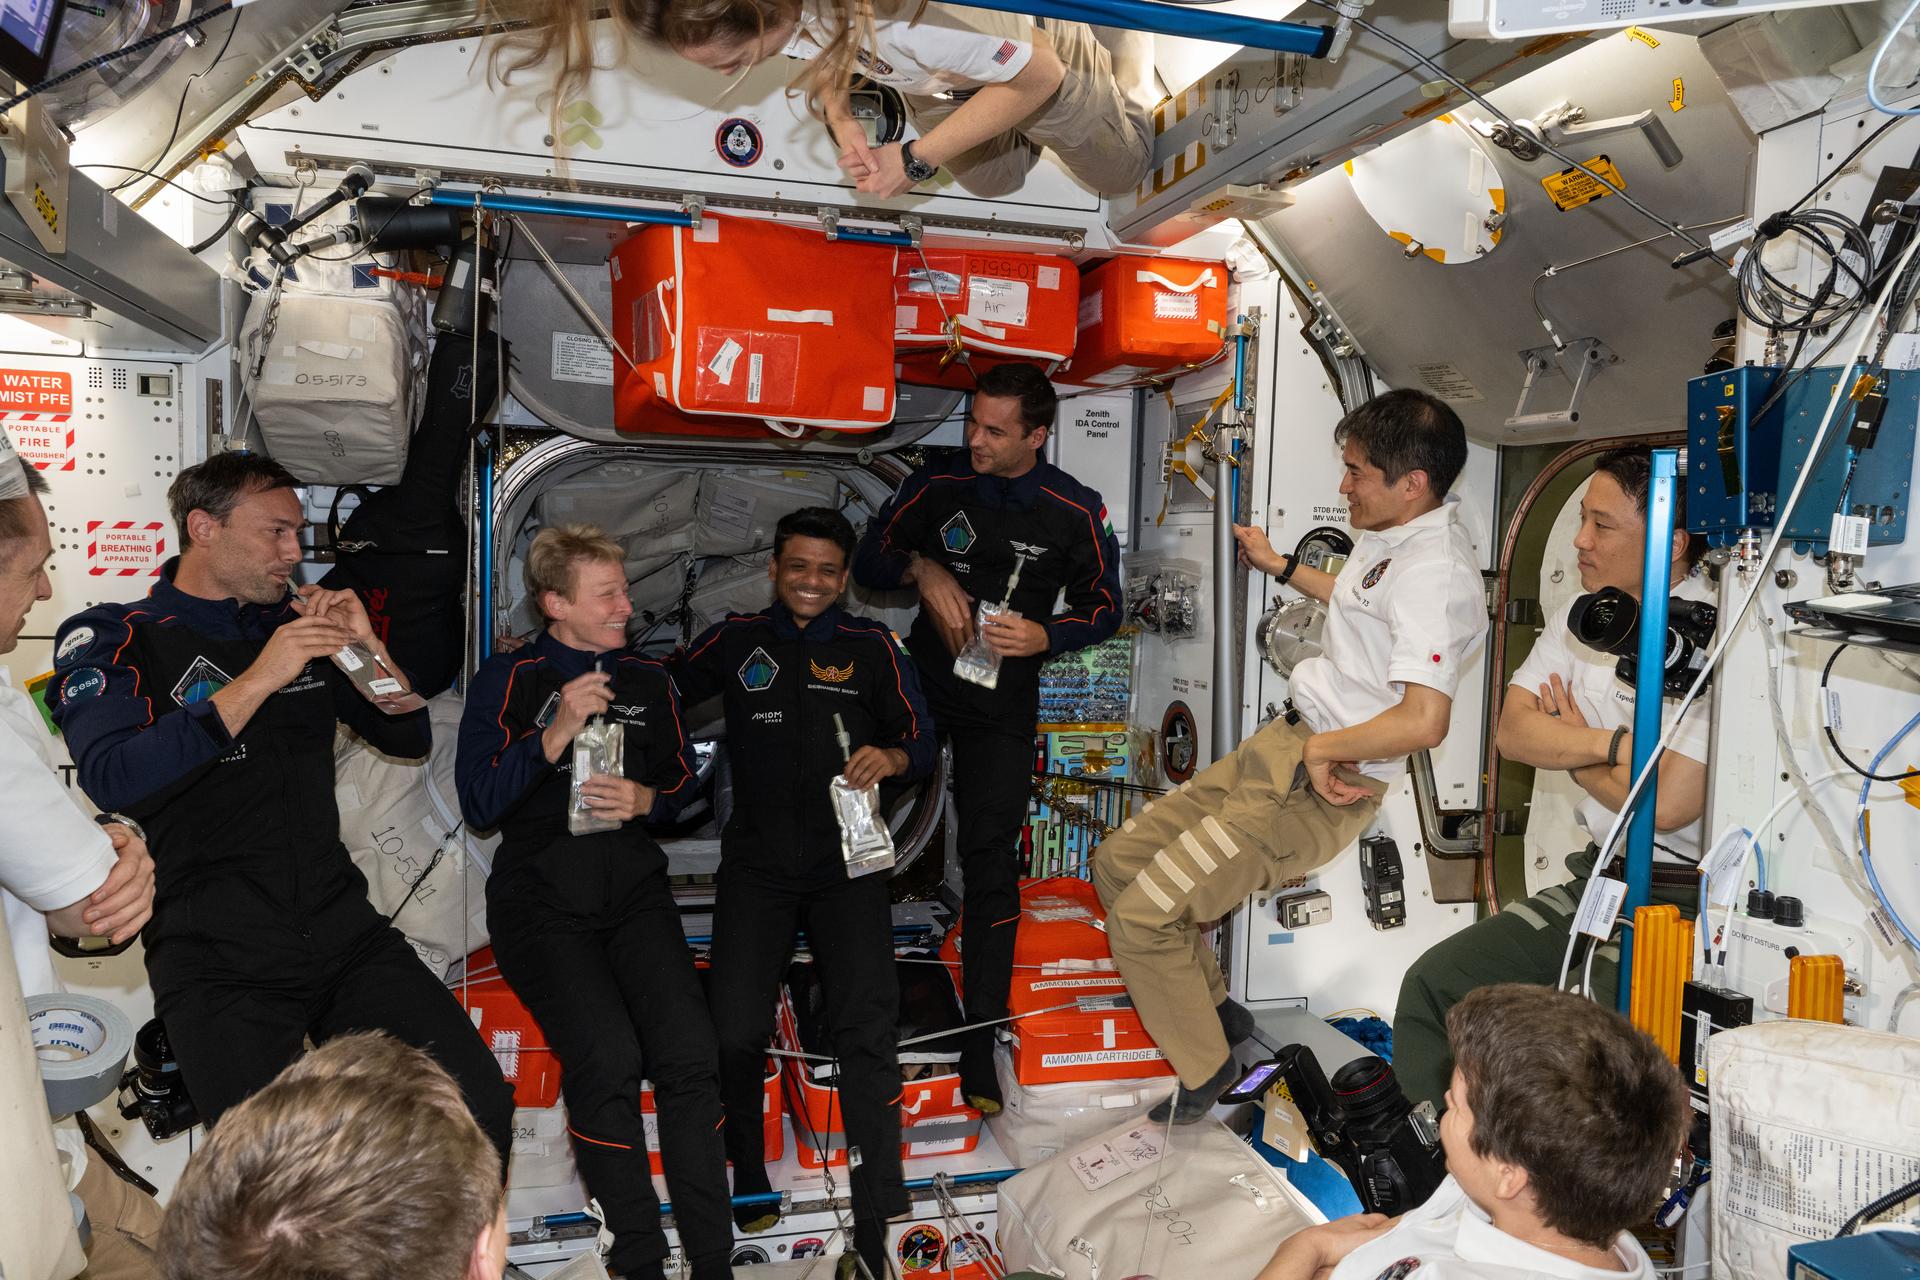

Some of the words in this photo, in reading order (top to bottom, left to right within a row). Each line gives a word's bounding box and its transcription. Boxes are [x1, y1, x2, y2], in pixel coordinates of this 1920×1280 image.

[4, 375, 63, 389] WATER
[0, 390, 35, 403] MIST
[40, 393, 70, 405] PFE
[1086, 409, 1110, 417] Zenith
[1075, 419, 1090, 427] IDA
[1091, 420, 1120, 428] Control
[9, 425, 61, 433] PORTABLE
[1086, 430, 1108, 438] Panel
[20, 437, 51, 447] FIRE
[100, 544, 152, 553] BREATHING
[65, 632, 84, 648] ignis
[752, 711, 782, 720] AXIOM
[1741, 933, 1754, 942] NOT
[1754, 937, 1780, 951] DISTURB
[1033, 979, 1081, 990] AMMONIA
[1044, 1054, 1093, 1065] AMMONIA
[1096, 1050, 1152, 1062] CARTRIDGE
